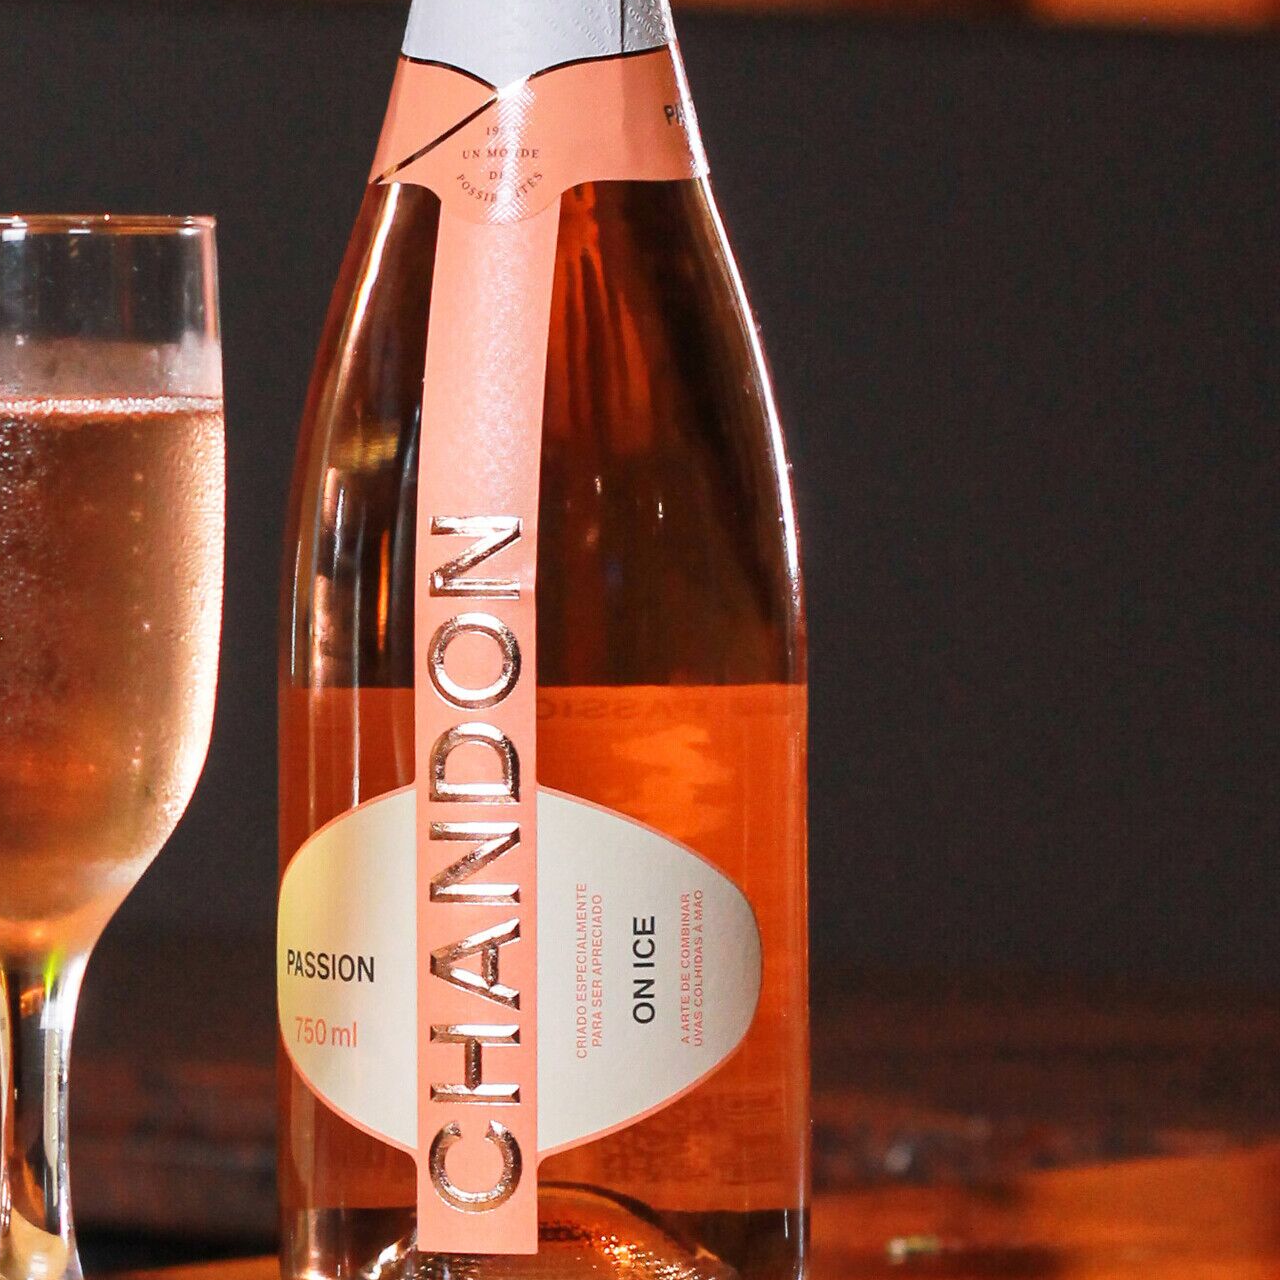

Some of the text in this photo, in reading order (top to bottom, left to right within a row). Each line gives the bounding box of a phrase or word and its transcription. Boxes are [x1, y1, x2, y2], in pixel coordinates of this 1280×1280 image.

[462, 149, 480, 159] UN
[427, 514, 523, 1214] CHANDON
[287, 948, 375, 983] PASSION
[576, 883, 587, 1059] CRIADO ESPECIALMENTE
[591, 894, 603, 1047] PARA SER APRECIADO
[632, 915, 655, 1024] ON ICE
[680, 893, 690, 1044] A ARTE DE COMBINAR
[694, 936, 703, 1008] COLHIDAS
[294, 1016, 357, 1048] 750 ml
[694, 1010, 703, 1047] UVAS
